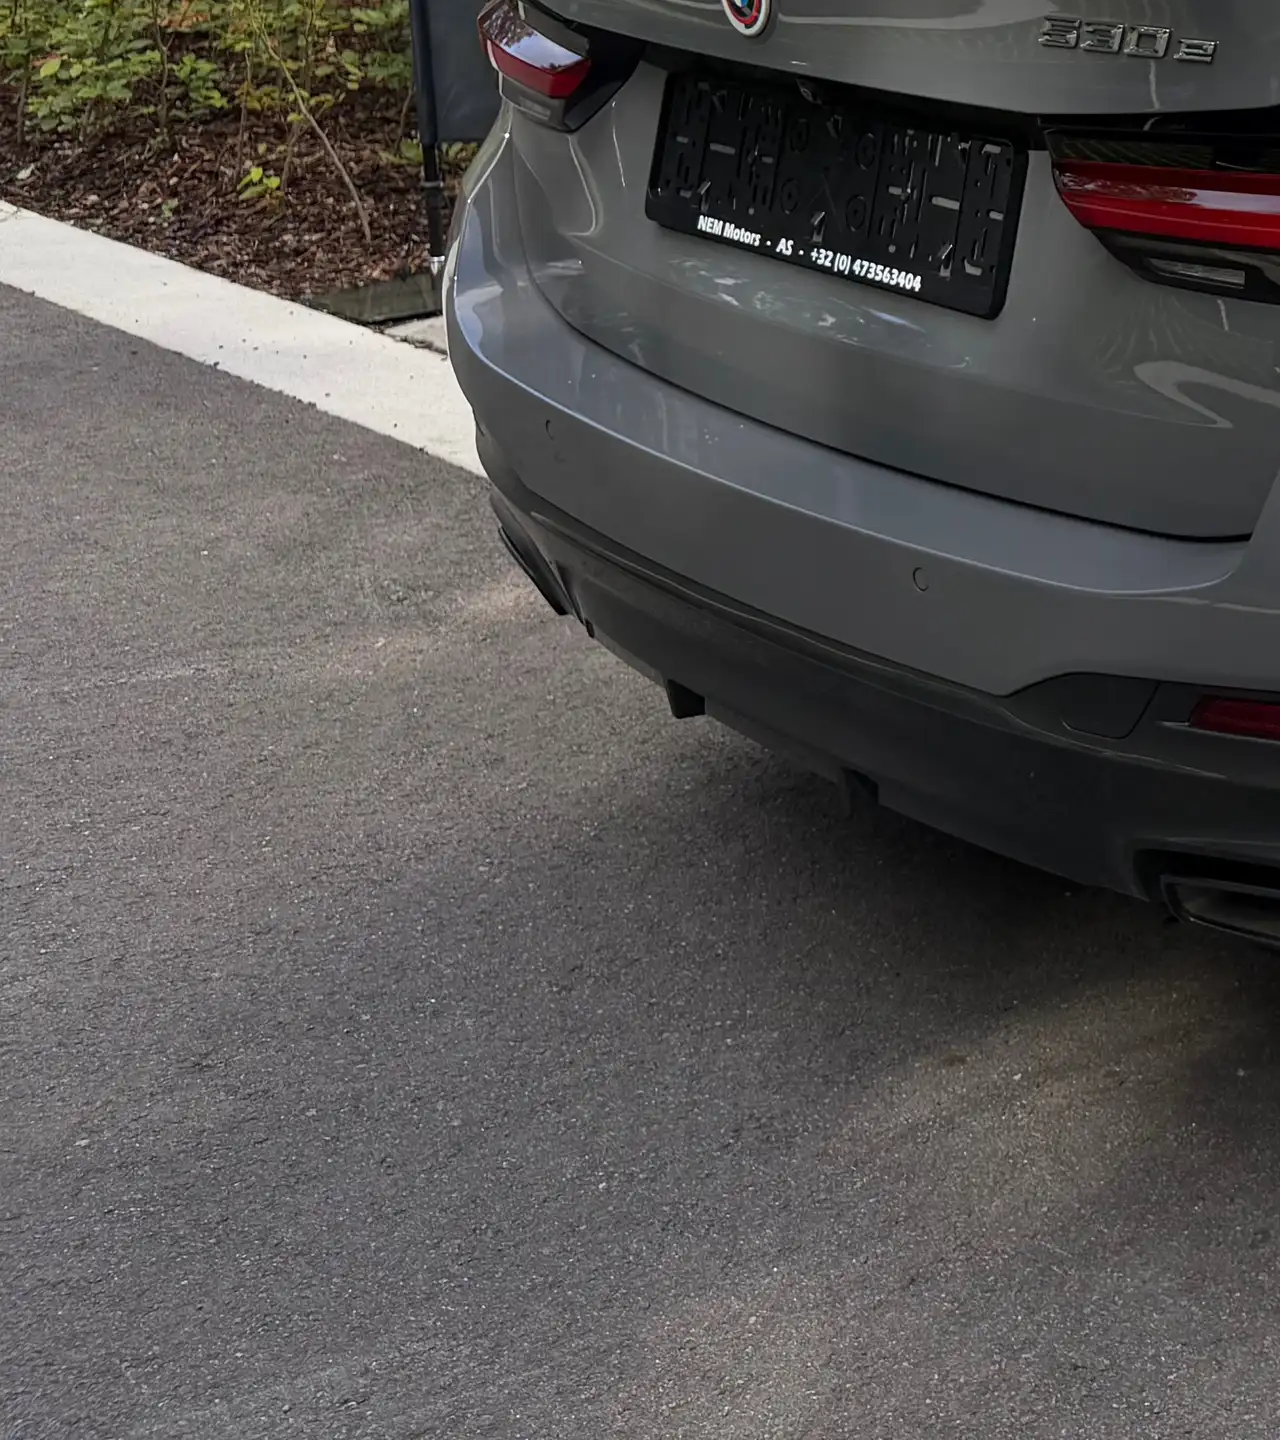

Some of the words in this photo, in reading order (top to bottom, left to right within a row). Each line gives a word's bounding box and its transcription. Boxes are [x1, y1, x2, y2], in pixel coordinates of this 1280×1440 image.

[697, 214, 723, 235] NEM
[723, 221, 762, 247] Motors
[775, 237, 794, 256] AS
[809, 247, 834, 268] +32
[833, 252, 852, 276] (0)
[852, 257, 922, 292] 473563404
